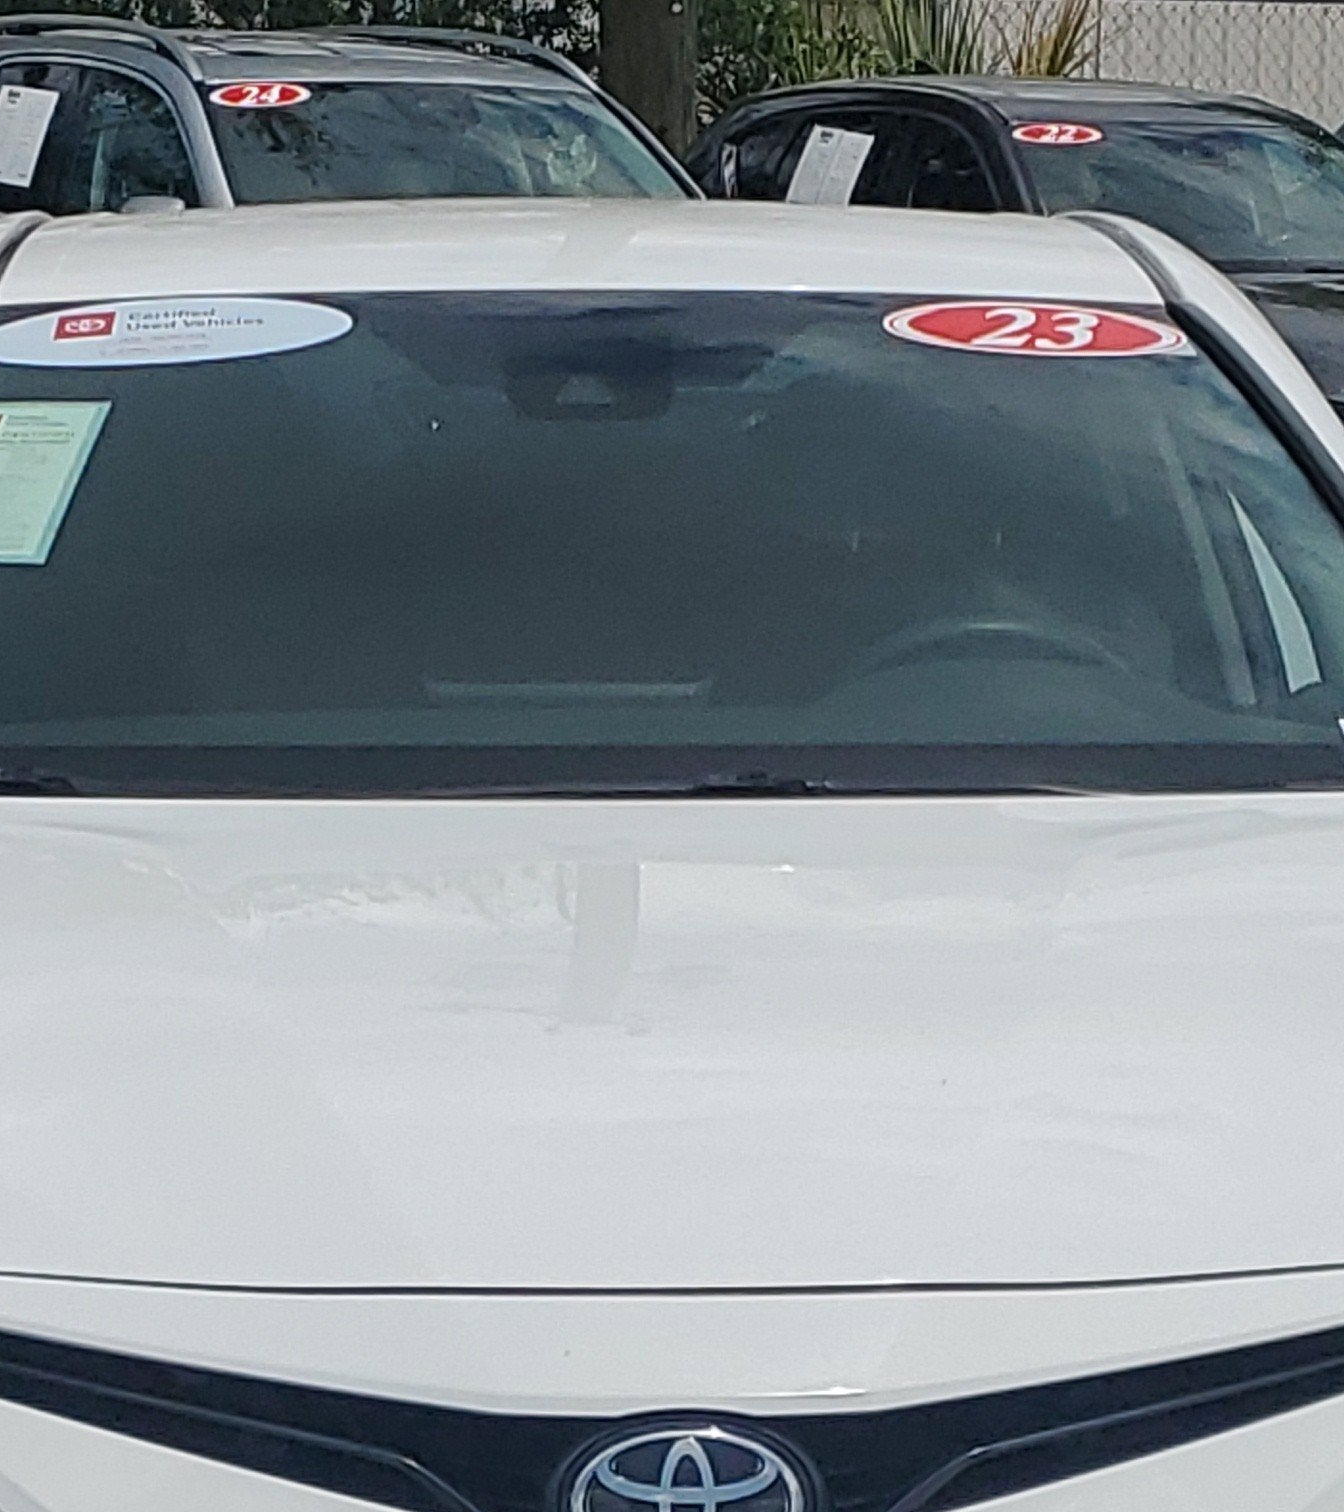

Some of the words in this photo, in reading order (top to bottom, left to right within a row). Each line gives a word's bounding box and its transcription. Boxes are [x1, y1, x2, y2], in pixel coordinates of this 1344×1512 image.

[239, 85, 282, 104] 24
[1038, 124, 1078, 142] 22
[970, 307, 1099, 349] 23
